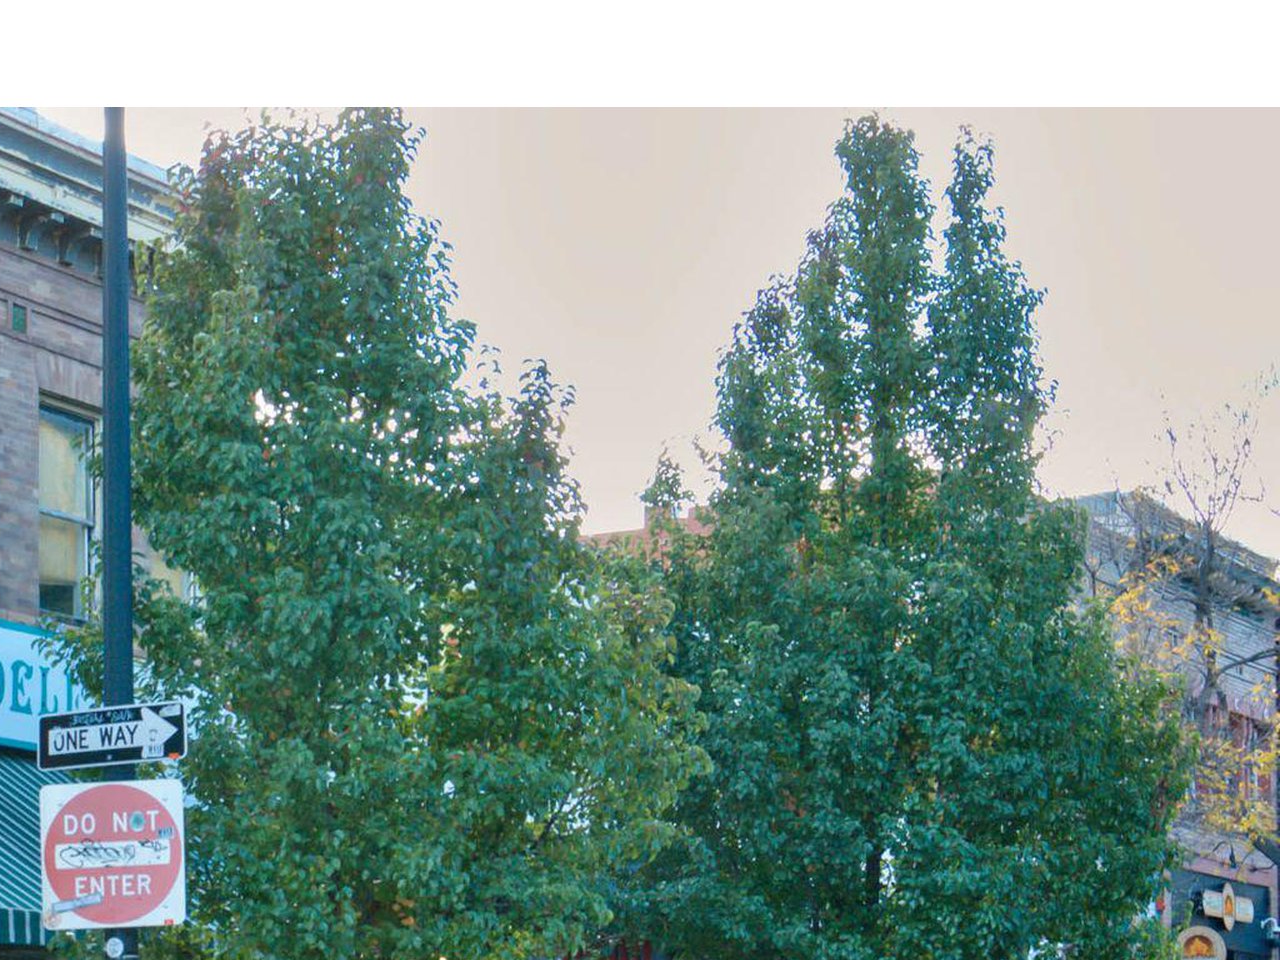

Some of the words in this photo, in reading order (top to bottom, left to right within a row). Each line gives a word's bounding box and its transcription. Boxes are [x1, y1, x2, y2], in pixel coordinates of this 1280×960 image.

[53, 729, 89, 752] ONE
[99, 724, 139, 748] WAY
[63, 812, 96, 836] DO
[112, 809, 160, 833] NOT
[74, 873, 152, 897] ENTER
